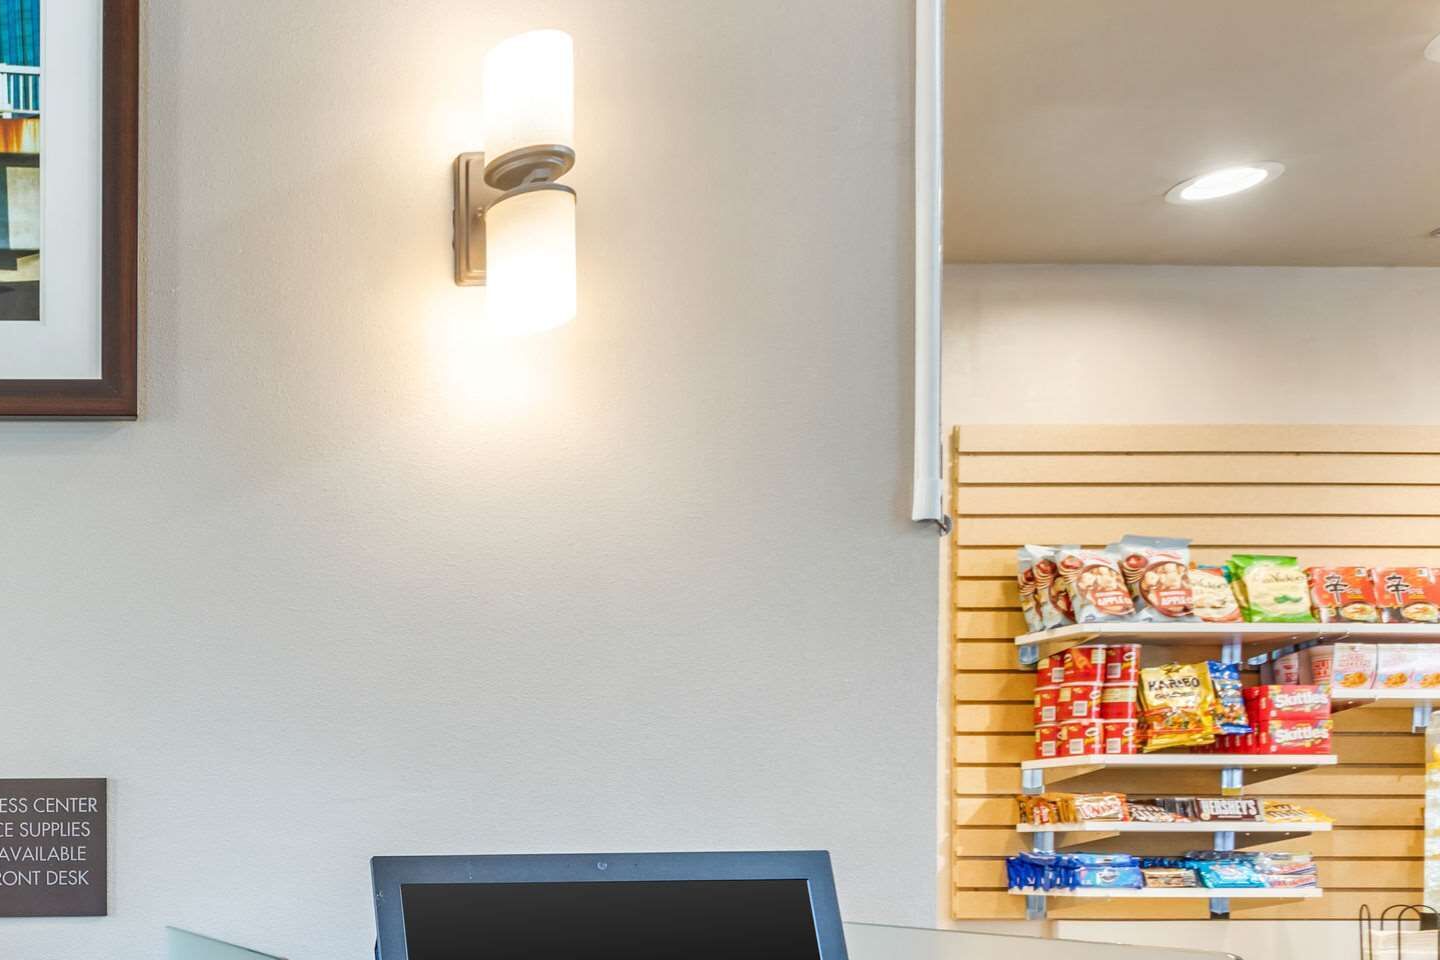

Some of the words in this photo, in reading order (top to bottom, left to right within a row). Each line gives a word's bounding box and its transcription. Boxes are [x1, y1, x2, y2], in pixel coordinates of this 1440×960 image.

[33, 797, 98, 813] CENTER
[19, 821, 91, 837] SUPPLIES
[46, 870, 89, 886] DESK
